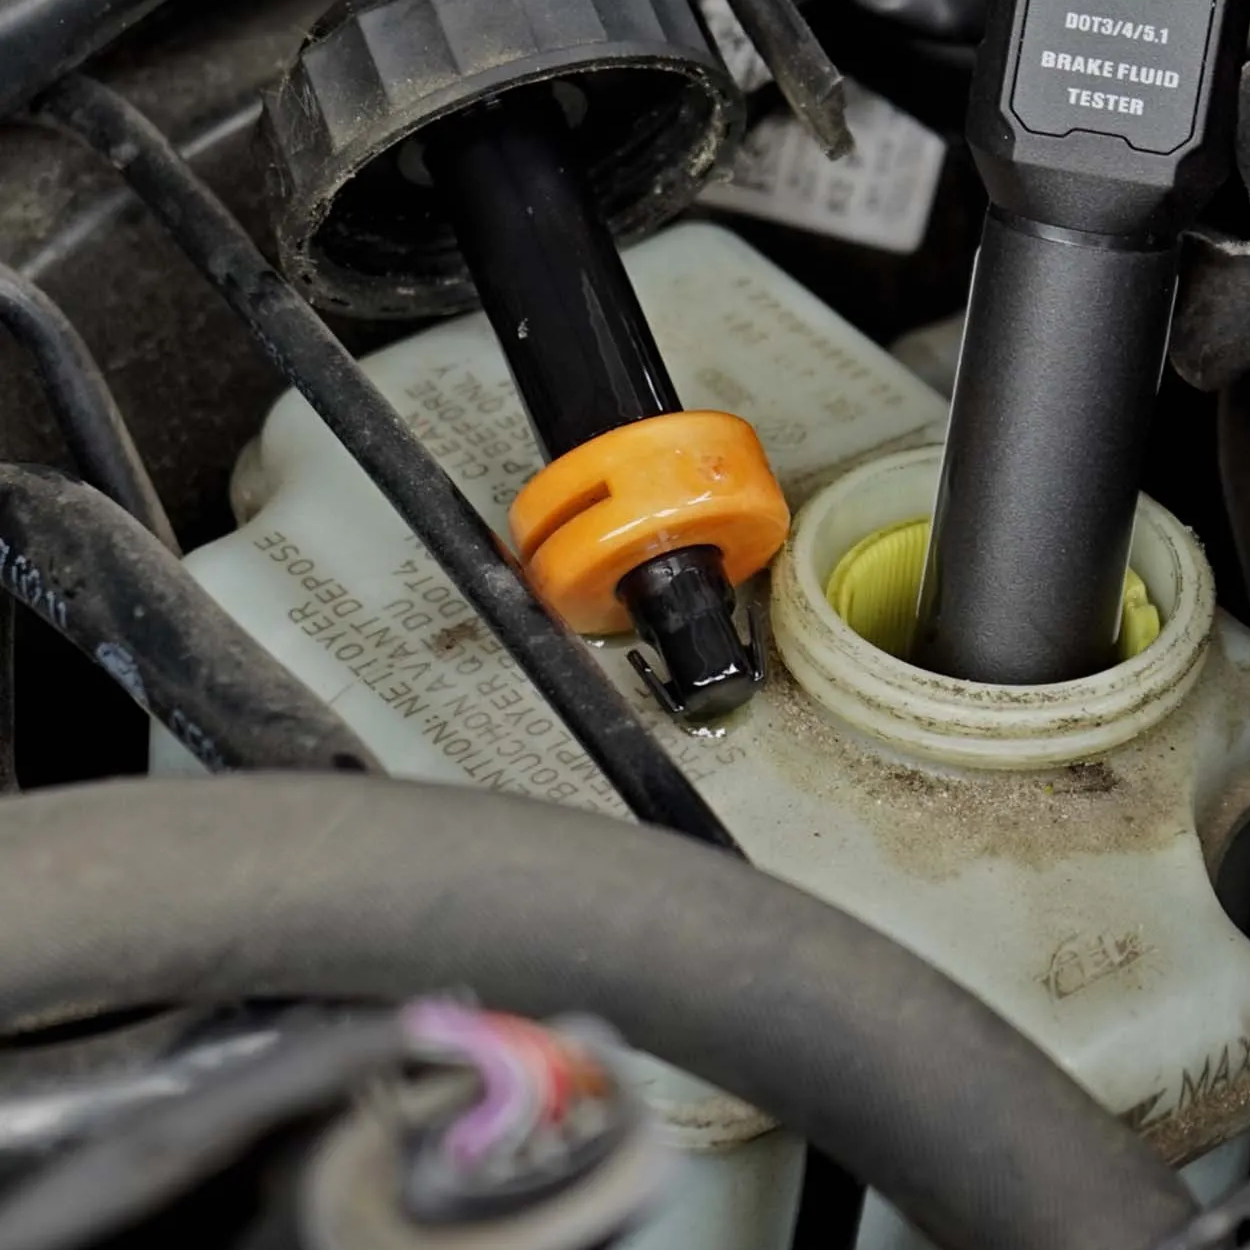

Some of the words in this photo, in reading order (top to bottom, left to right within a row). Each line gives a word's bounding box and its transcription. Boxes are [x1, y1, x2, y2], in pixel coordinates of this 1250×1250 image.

[1065, 12, 1169, 44] DOT3/4/5.1
[1041, 51, 1114, 78] BRAKE
[1117, 63, 1180, 89] FLUID
[1067, 88, 1144, 116] TESTER
[403, 379, 512, 460] BEFORE
[251, 528, 363, 618] DEPOSE
[391, 558, 468, 619] DOT4
[381, 595, 433, 631] DU
[285, 600, 430, 718] NETTOYER
[421, 713, 530, 793] NTION:
[443, 692, 578, 802] BOUCHON
